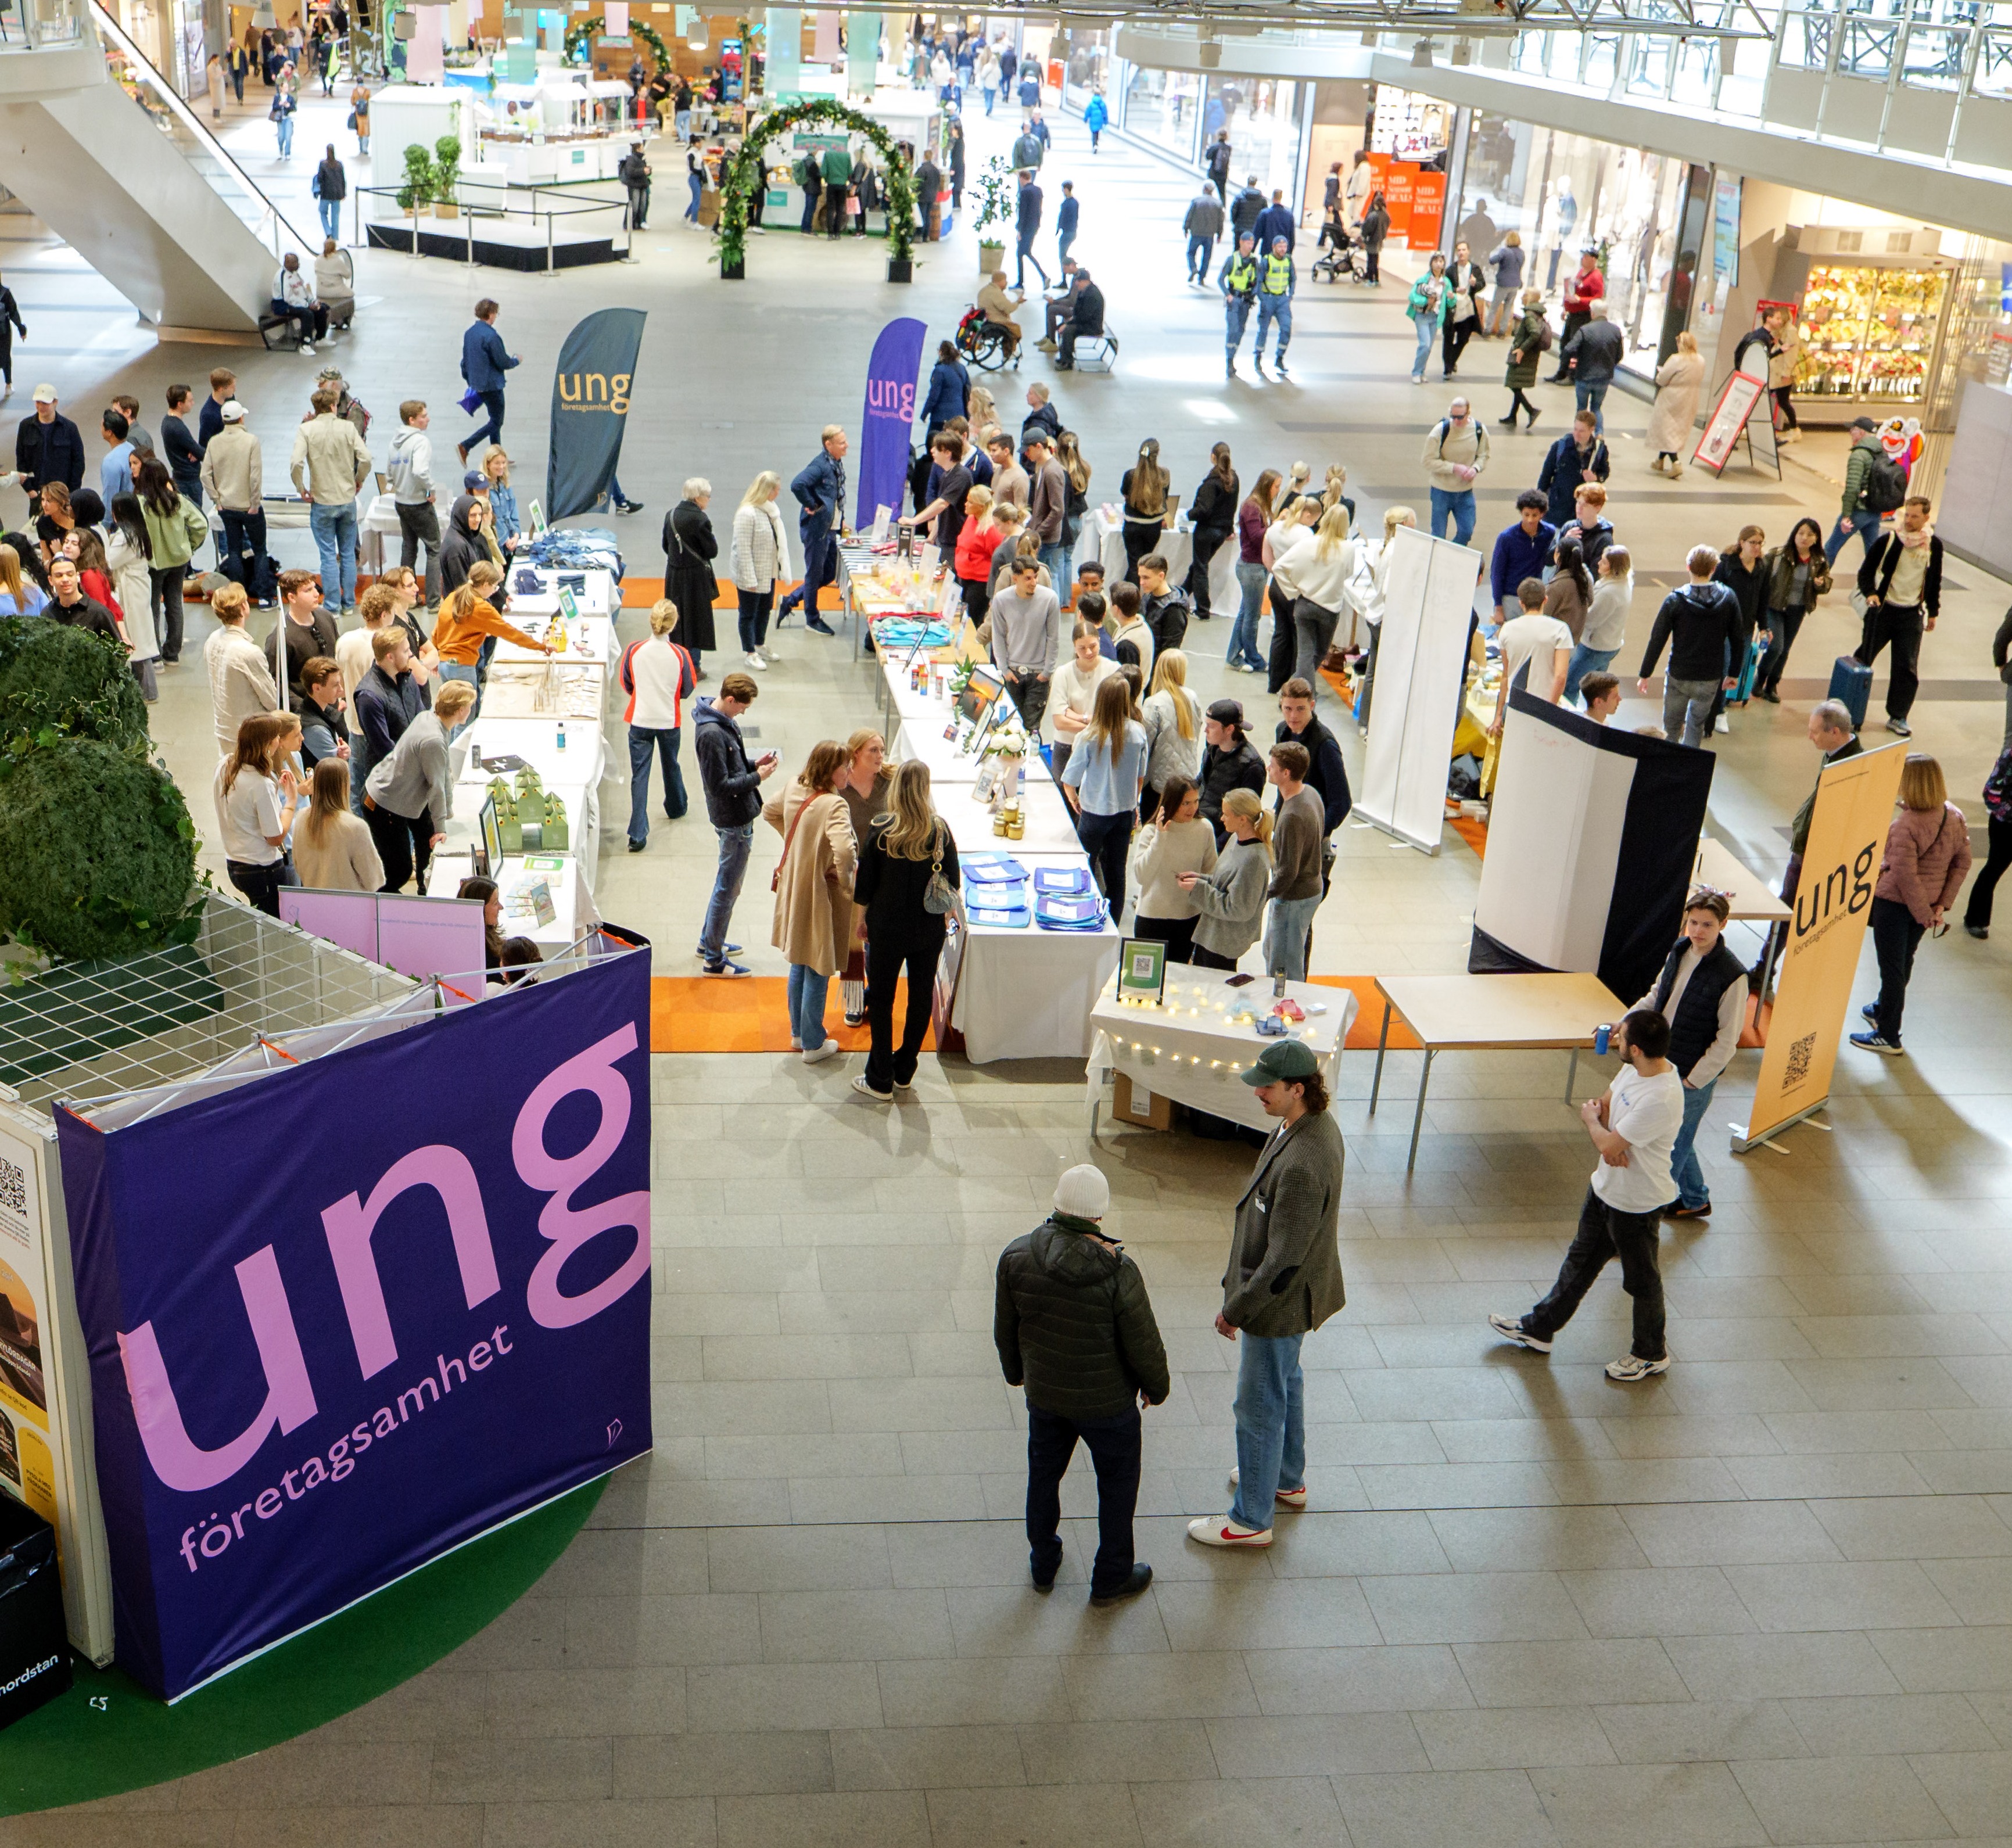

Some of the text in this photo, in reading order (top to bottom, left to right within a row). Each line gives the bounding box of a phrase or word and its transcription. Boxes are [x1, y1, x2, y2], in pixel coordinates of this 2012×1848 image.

[1386, 193, 1413, 203] DEALS
[1388, 175, 1407, 185] MID
[1416, 186, 1436, 196] MID
[1414, 205, 1443, 214] DEALS
[558, 373, 631, 415] ung
[869, 379, 914, 423] ung
[1795, 839, 1877, 938] ung
[1793, 909, 1848, 957] företagsamhet
[116, 1020, 651, 1492] ung
[179, 1323, 514, 1574] företagsamhet
[0, 1655, 59, 1697] nordstan
